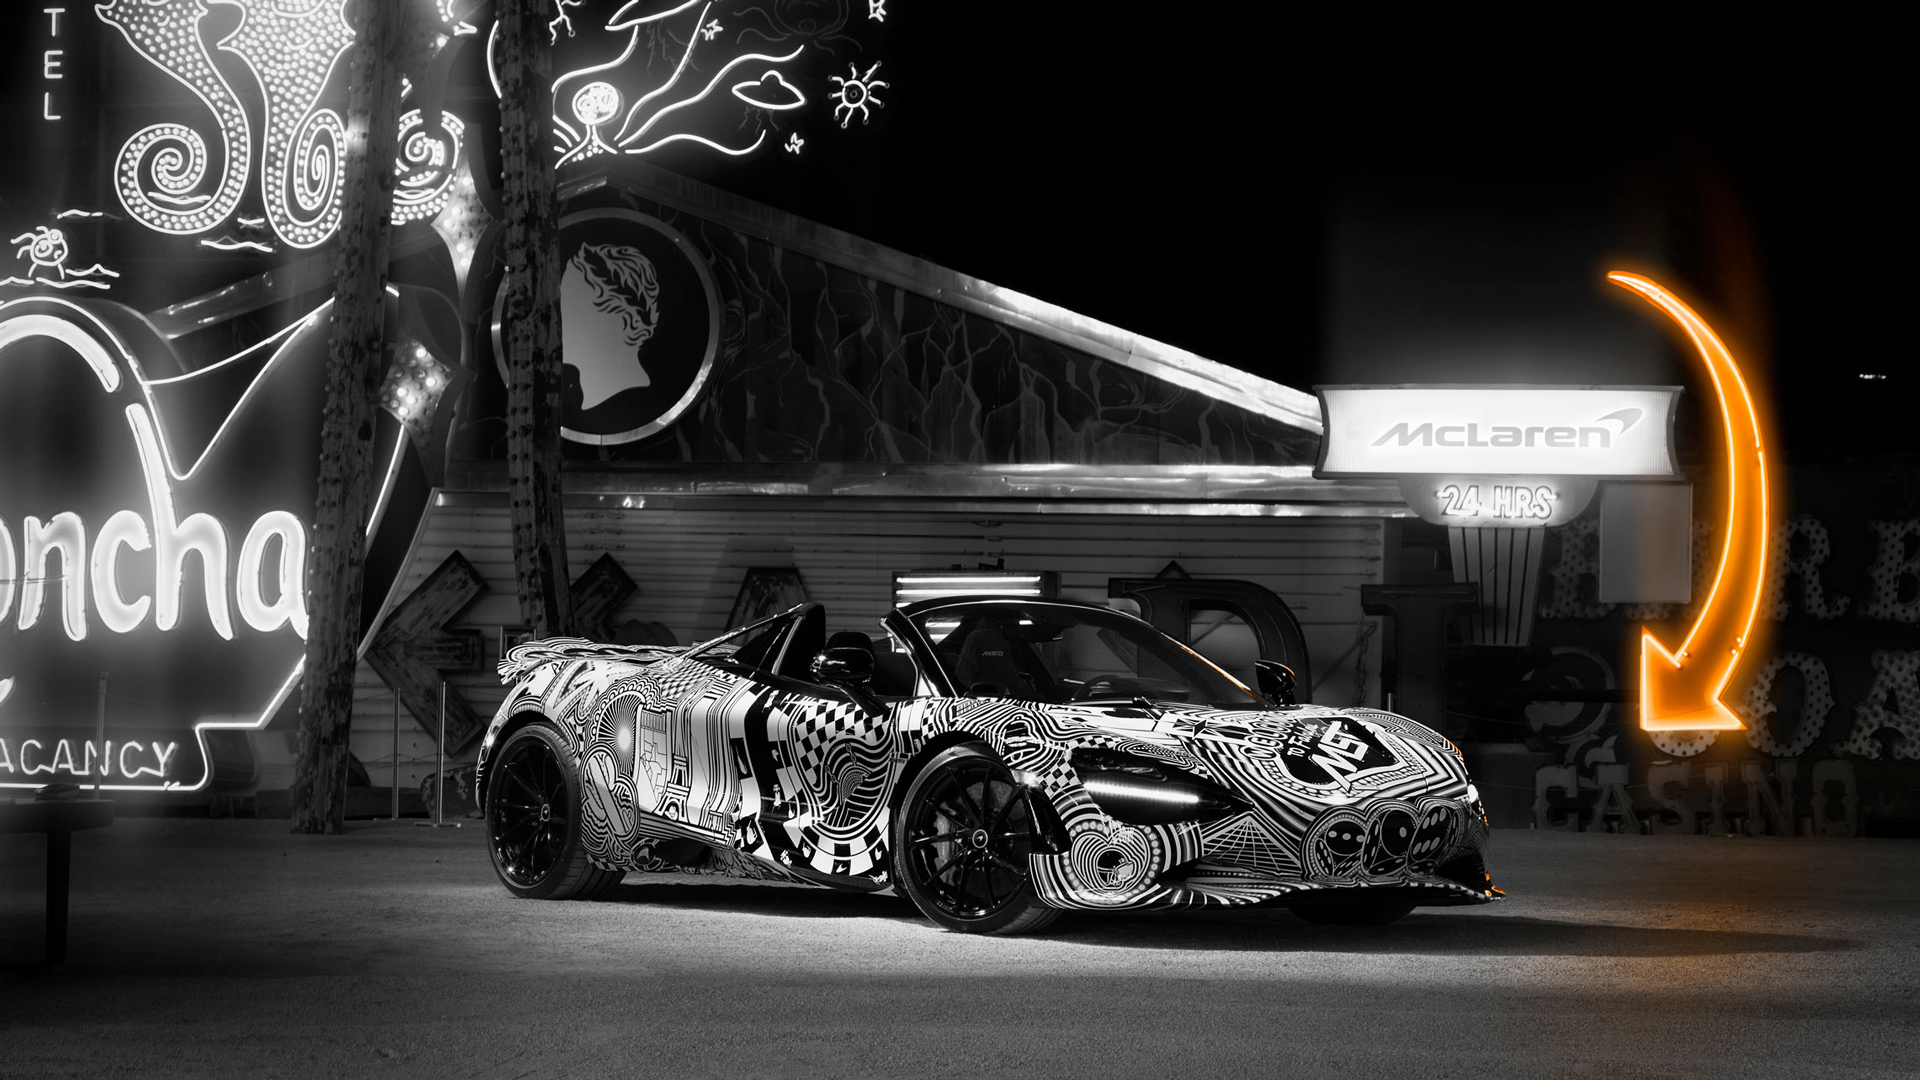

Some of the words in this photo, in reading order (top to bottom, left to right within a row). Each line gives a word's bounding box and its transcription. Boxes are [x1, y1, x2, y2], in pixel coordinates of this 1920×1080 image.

[43, 8, 66, 120] TEL
[1371, 421, 1611, 448] McLaren
[1441, 484, 1482, 517] 24
[1492, 484, 1554, 519] HRS
[1538, 515, 1920, 624] BRB
[1648, 650, 1920, 761] OA
[1533, 758, 1860, 838] CASINO
